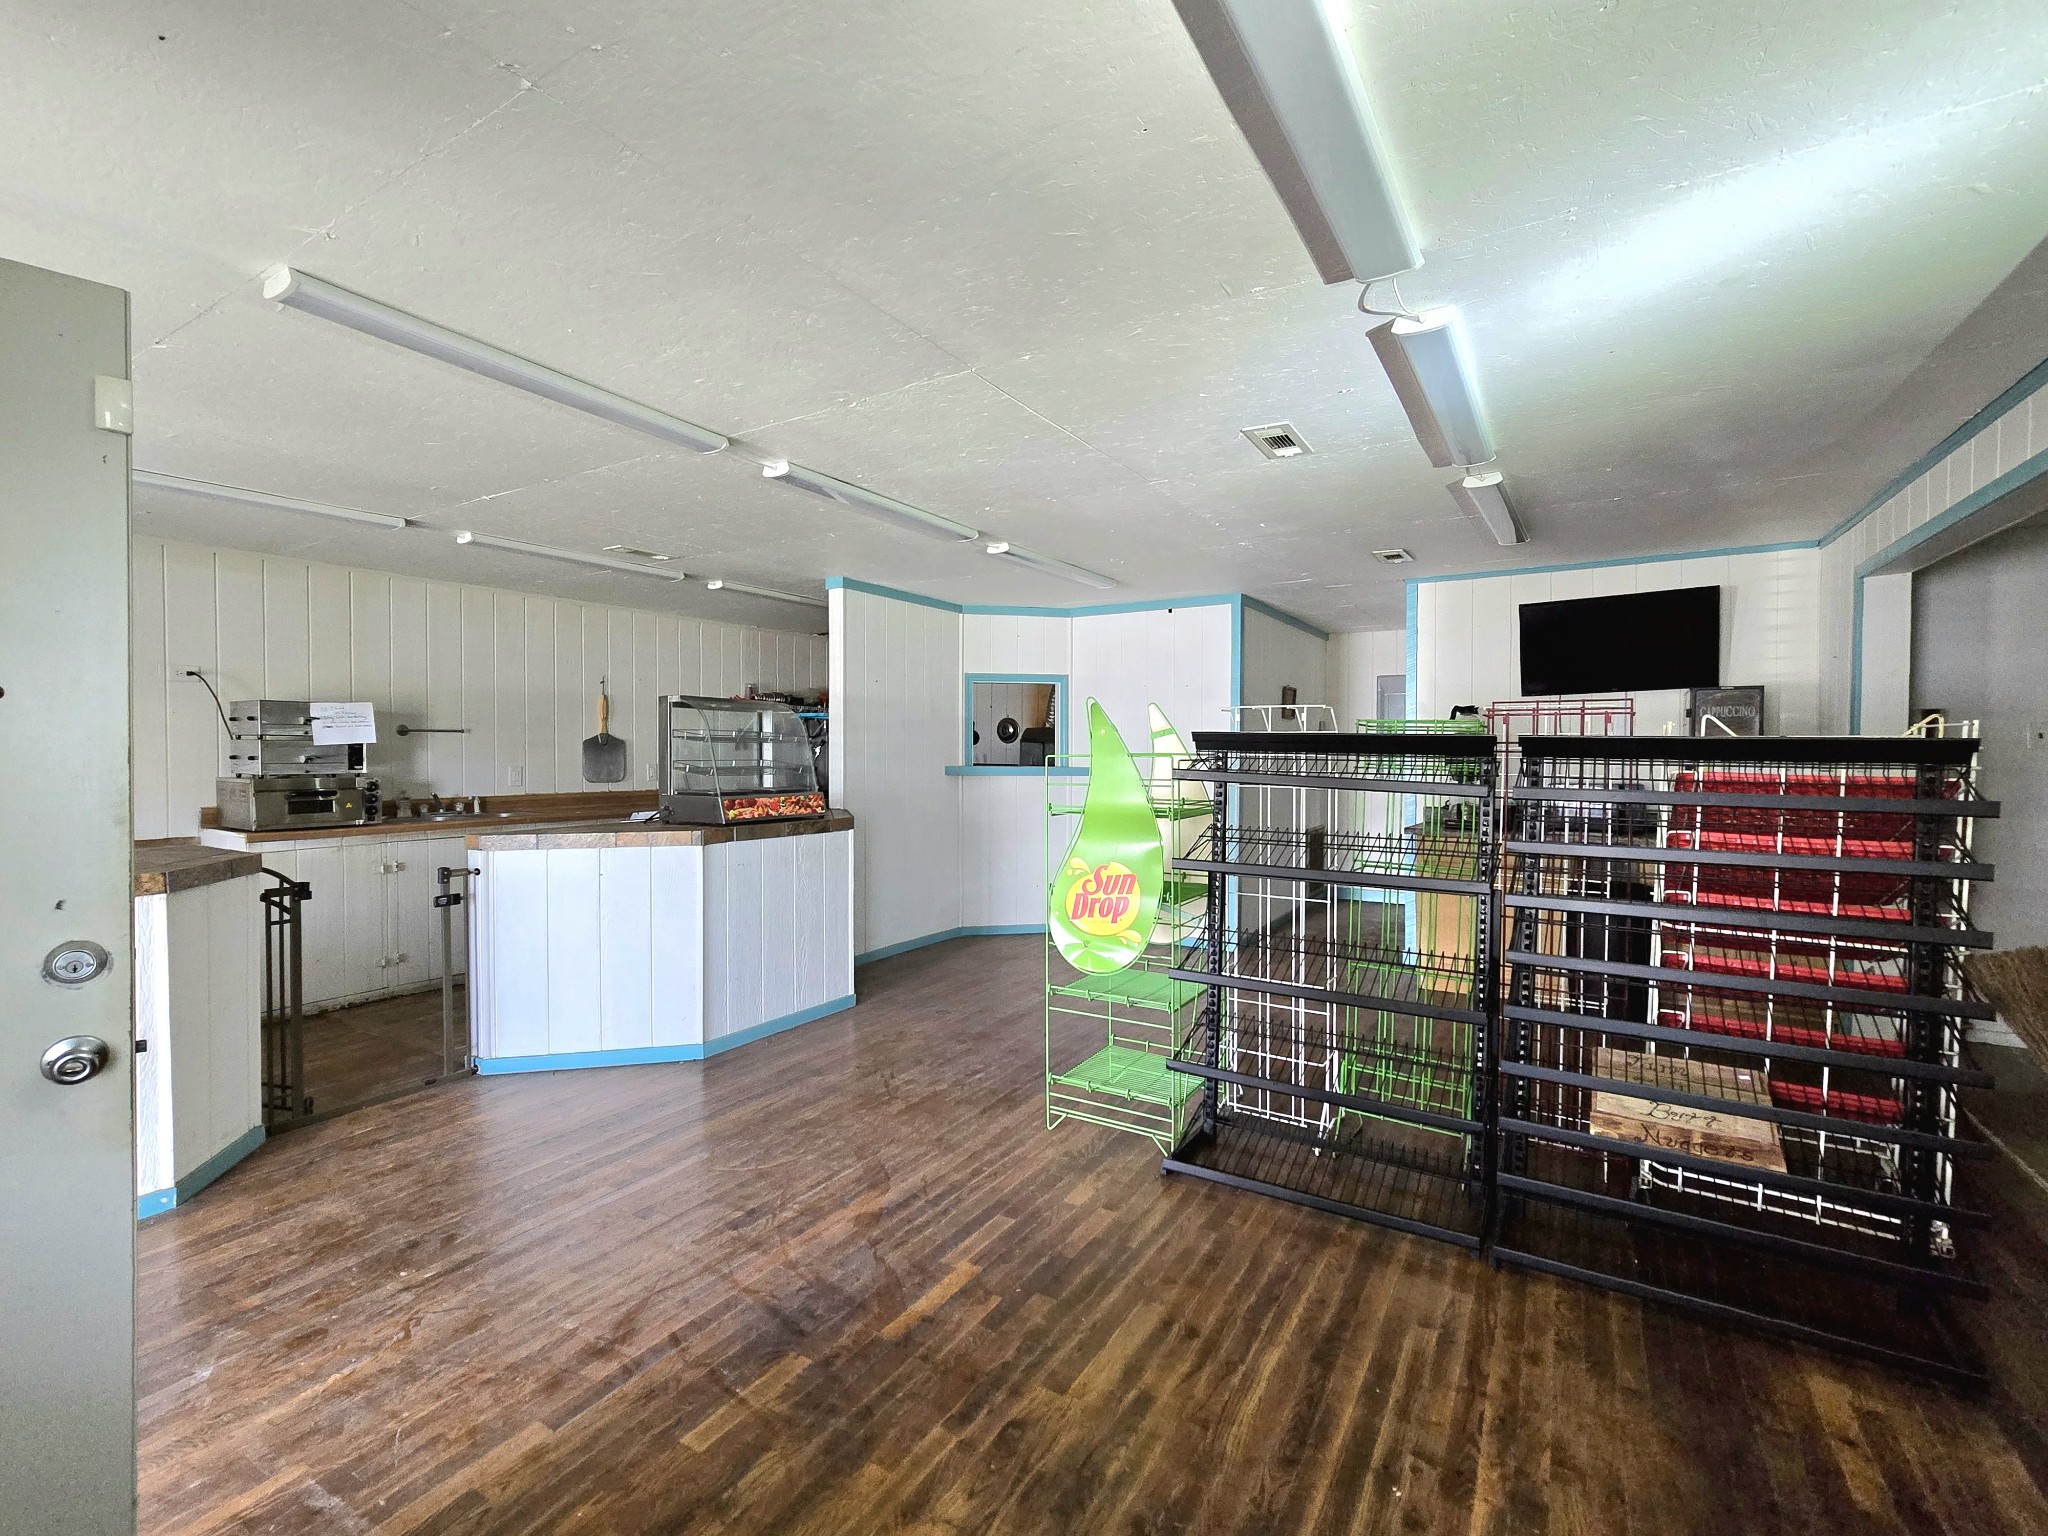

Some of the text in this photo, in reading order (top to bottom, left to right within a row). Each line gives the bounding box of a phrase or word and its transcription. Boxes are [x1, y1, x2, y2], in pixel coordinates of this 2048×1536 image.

[1700, 705, 1756, 717] CAPPUCCINO
[1082, 865, 1136, 896] Sun
[1071, 893, 1129, 924] Drop
[1634, 1123, 1754, 1161] Nuggets
